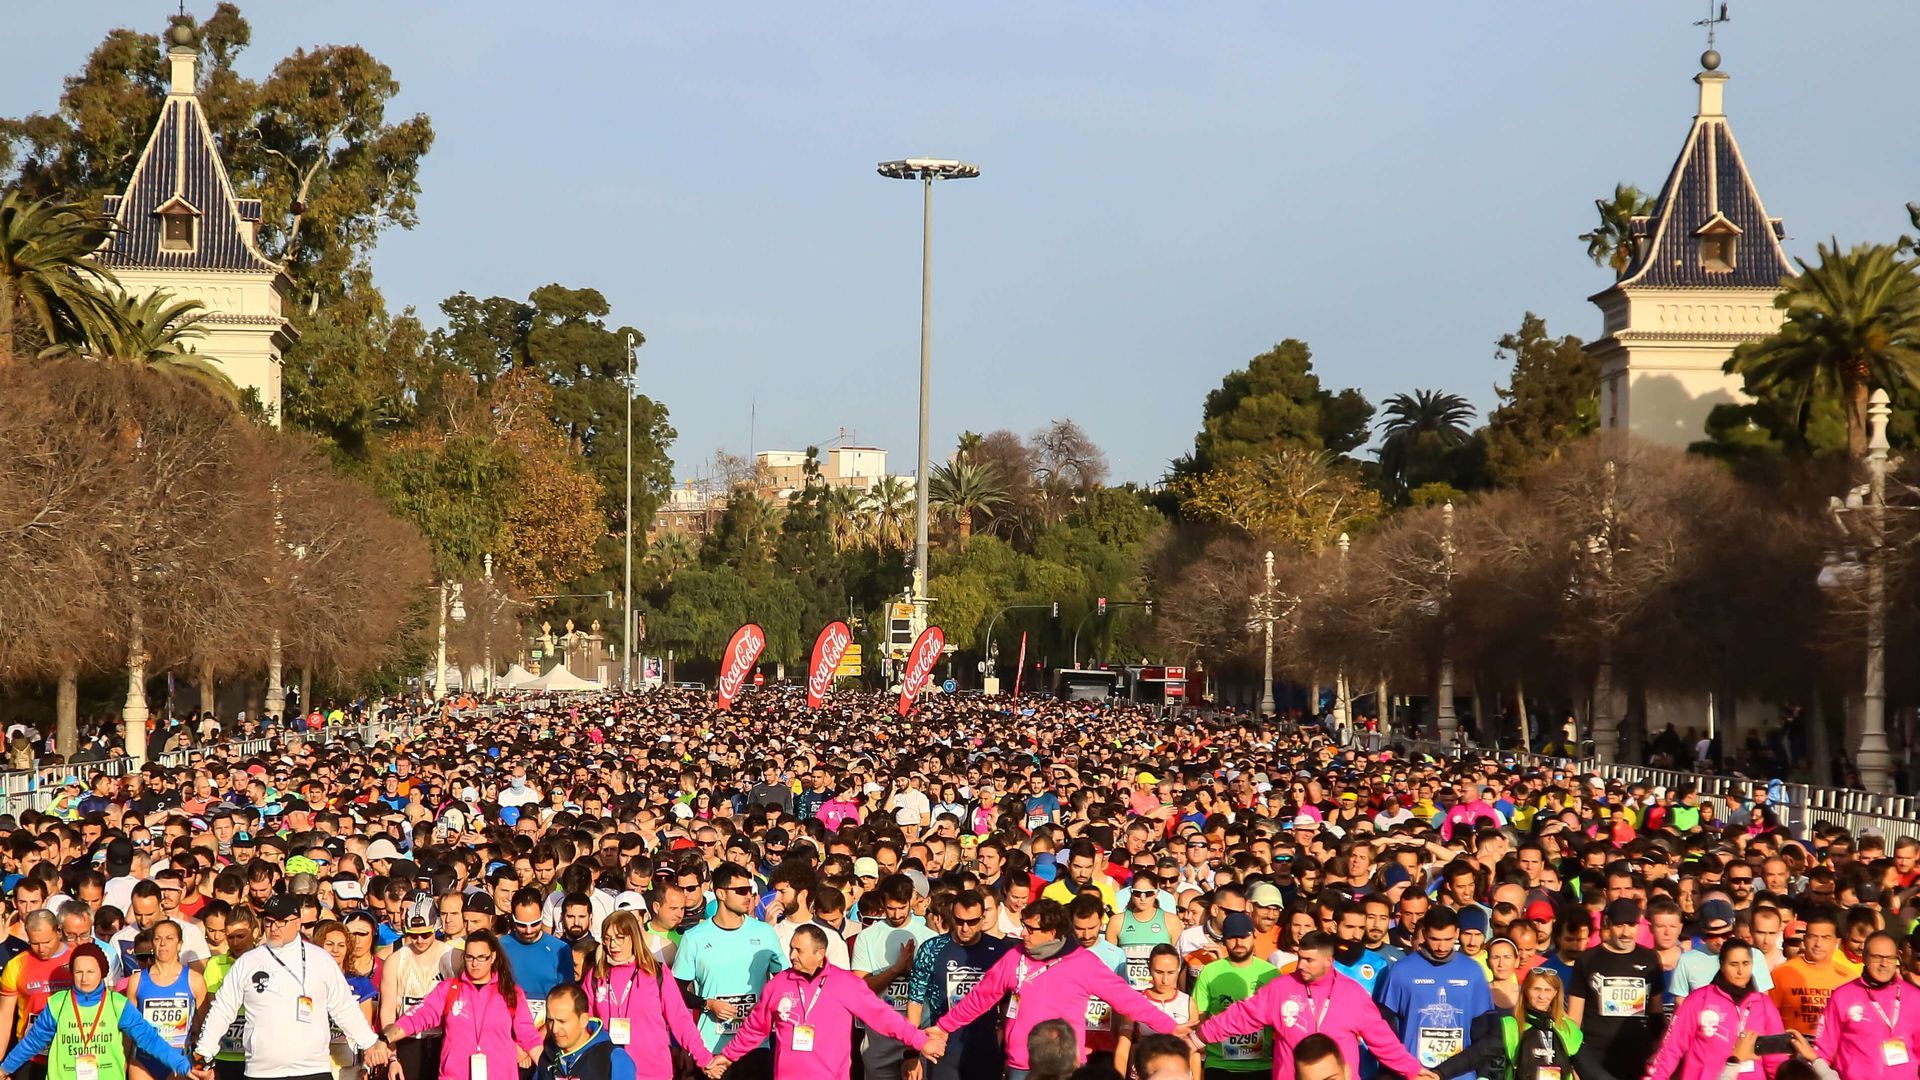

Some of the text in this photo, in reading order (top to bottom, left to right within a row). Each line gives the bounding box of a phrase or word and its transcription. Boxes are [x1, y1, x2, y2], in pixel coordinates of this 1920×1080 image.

[1129, 966, 1151, 977] 656
[887, 983, 909, 996] 570
[1612, 989, 1638, 1001] 6160
[152, 1010, 182, 1022] 6366
[1229, 1032, 1258, 1045] 6296
[1428, 1040, 1457, 1053] 4379
